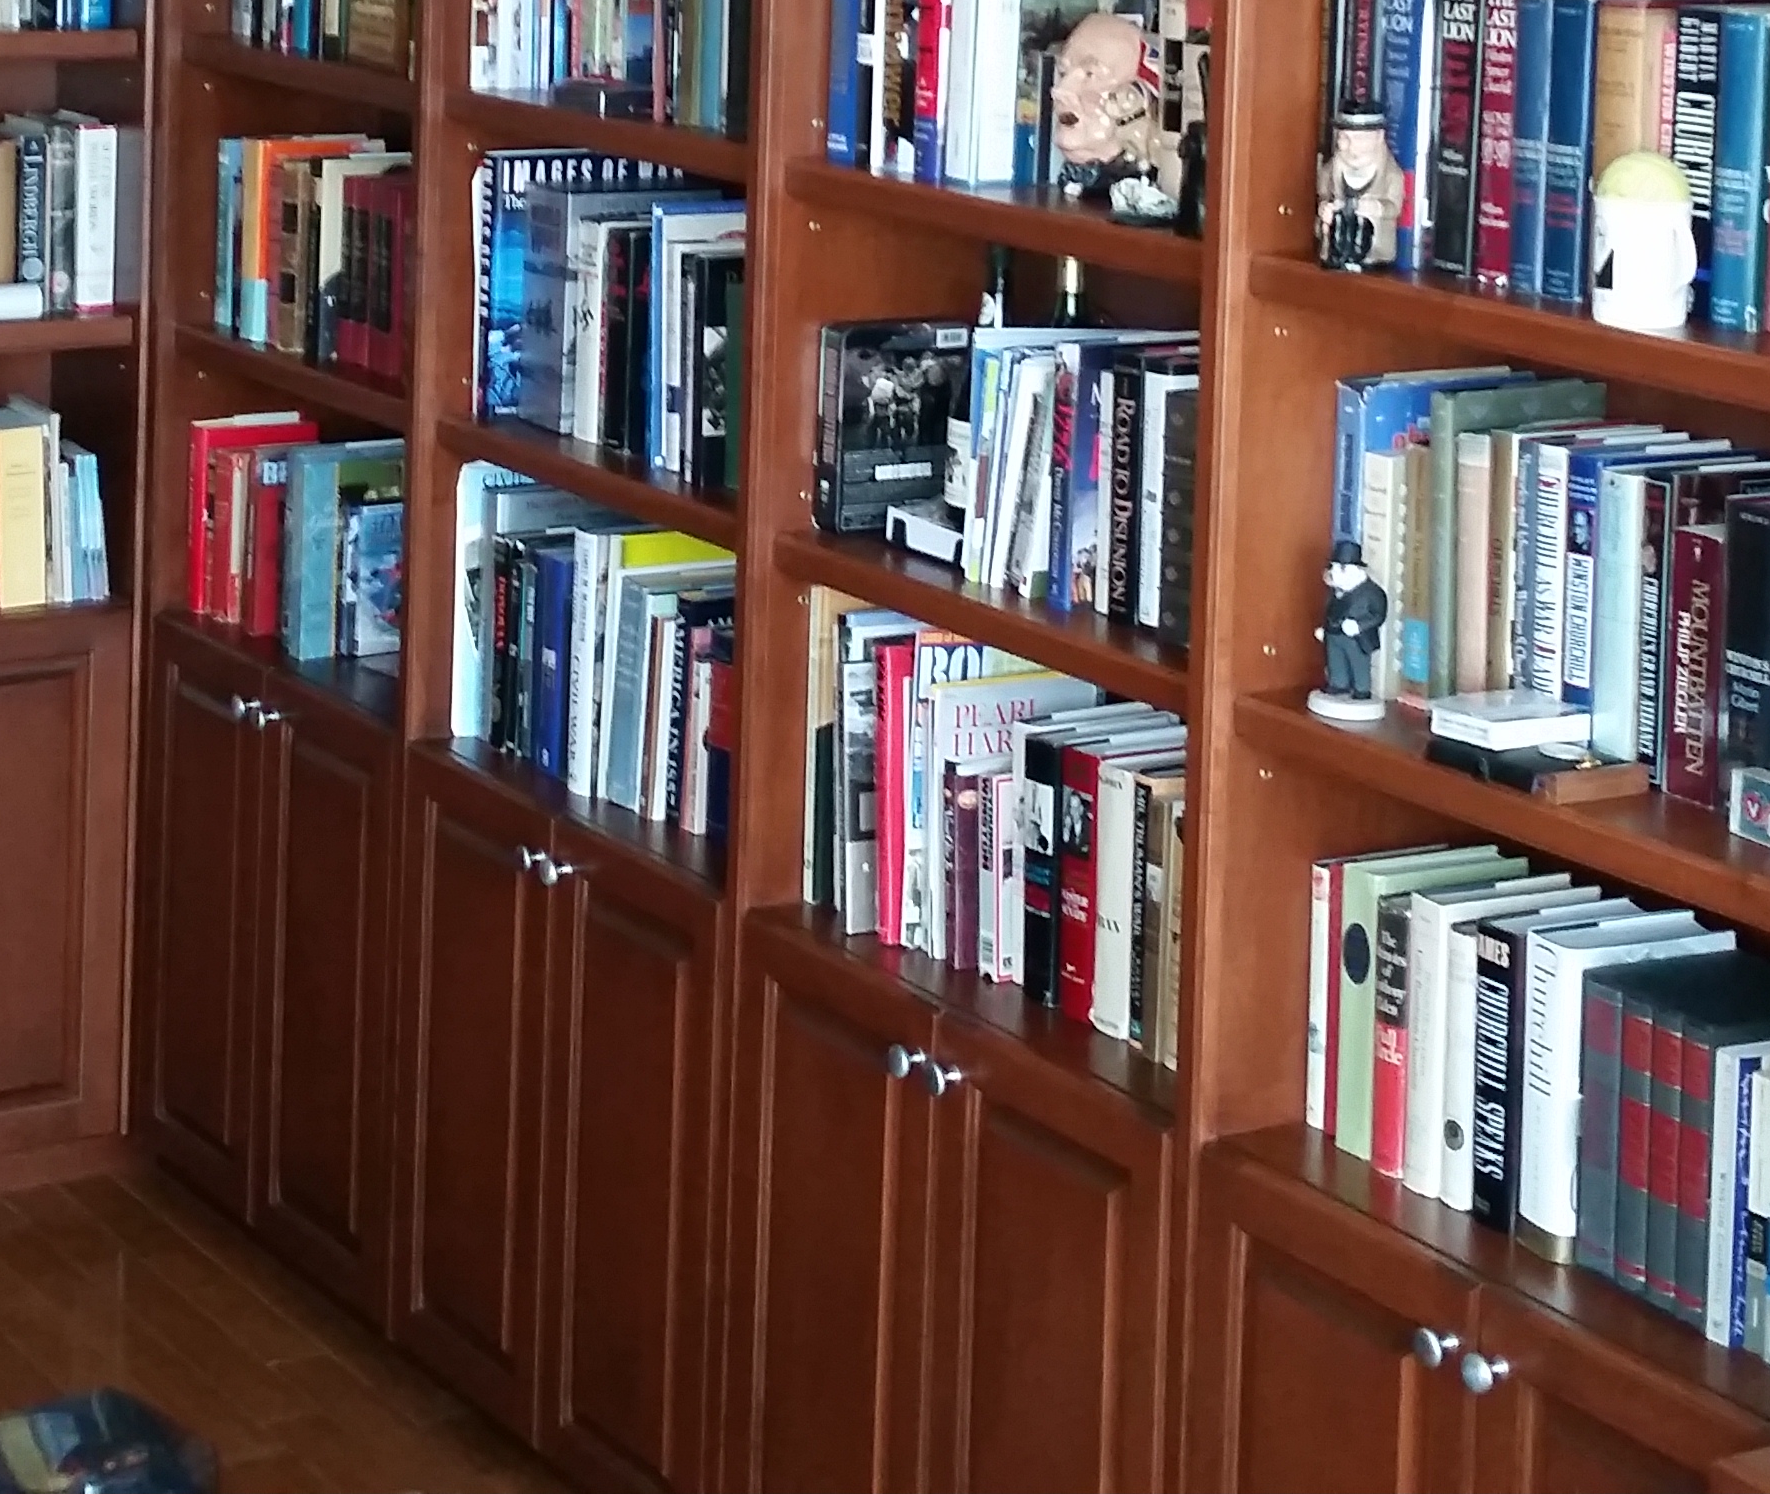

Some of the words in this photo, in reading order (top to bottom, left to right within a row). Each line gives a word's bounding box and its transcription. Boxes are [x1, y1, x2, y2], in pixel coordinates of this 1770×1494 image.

[1442, 2, 1477, 22] LAST
[1442, 24, 1476, 44] LION
[21, 154, 45, 258] LINDBERGH
[501, 158, 594, 194] IMAGES
[601, 157, 629, 183] OF
[1113, 396, 1137, 464] ROAD
[1112, 466, 1131, 496] TO
[1110, 497, 1134, 602] DISUNION
[1533, 476, 1561, 569] CHURCHILL
[1533, 579, 1557, 597] AS
[1570, 558, 1590, 612] WINSTON
[1531, 599, 1556, 636] WAR
[1567, 613, 1589, 683] CHURCHILL
[1675, 609, 1692, 664] PHILIP
[669, 612, 687, 722] AMERICA
[1530, 640, 1556, 704] LEADE
[1639, 653, 1658, 697] GRAND
[1683, 578, 1712, 777] MOUNTBATTEN
[1637, 699, 1656, 758] ALLIANCE
[1672, 664, 1690, 735] ZIEGLER
[668, 723, 681, 750] IN
[953, 729, 1014, 757] HAR
[1477, 974, 1511, 1093] CHURCHILL
[1529, 941, 1561, 1098] Churchill
[1474, 1097, 1508, 1181] SPEAKS
